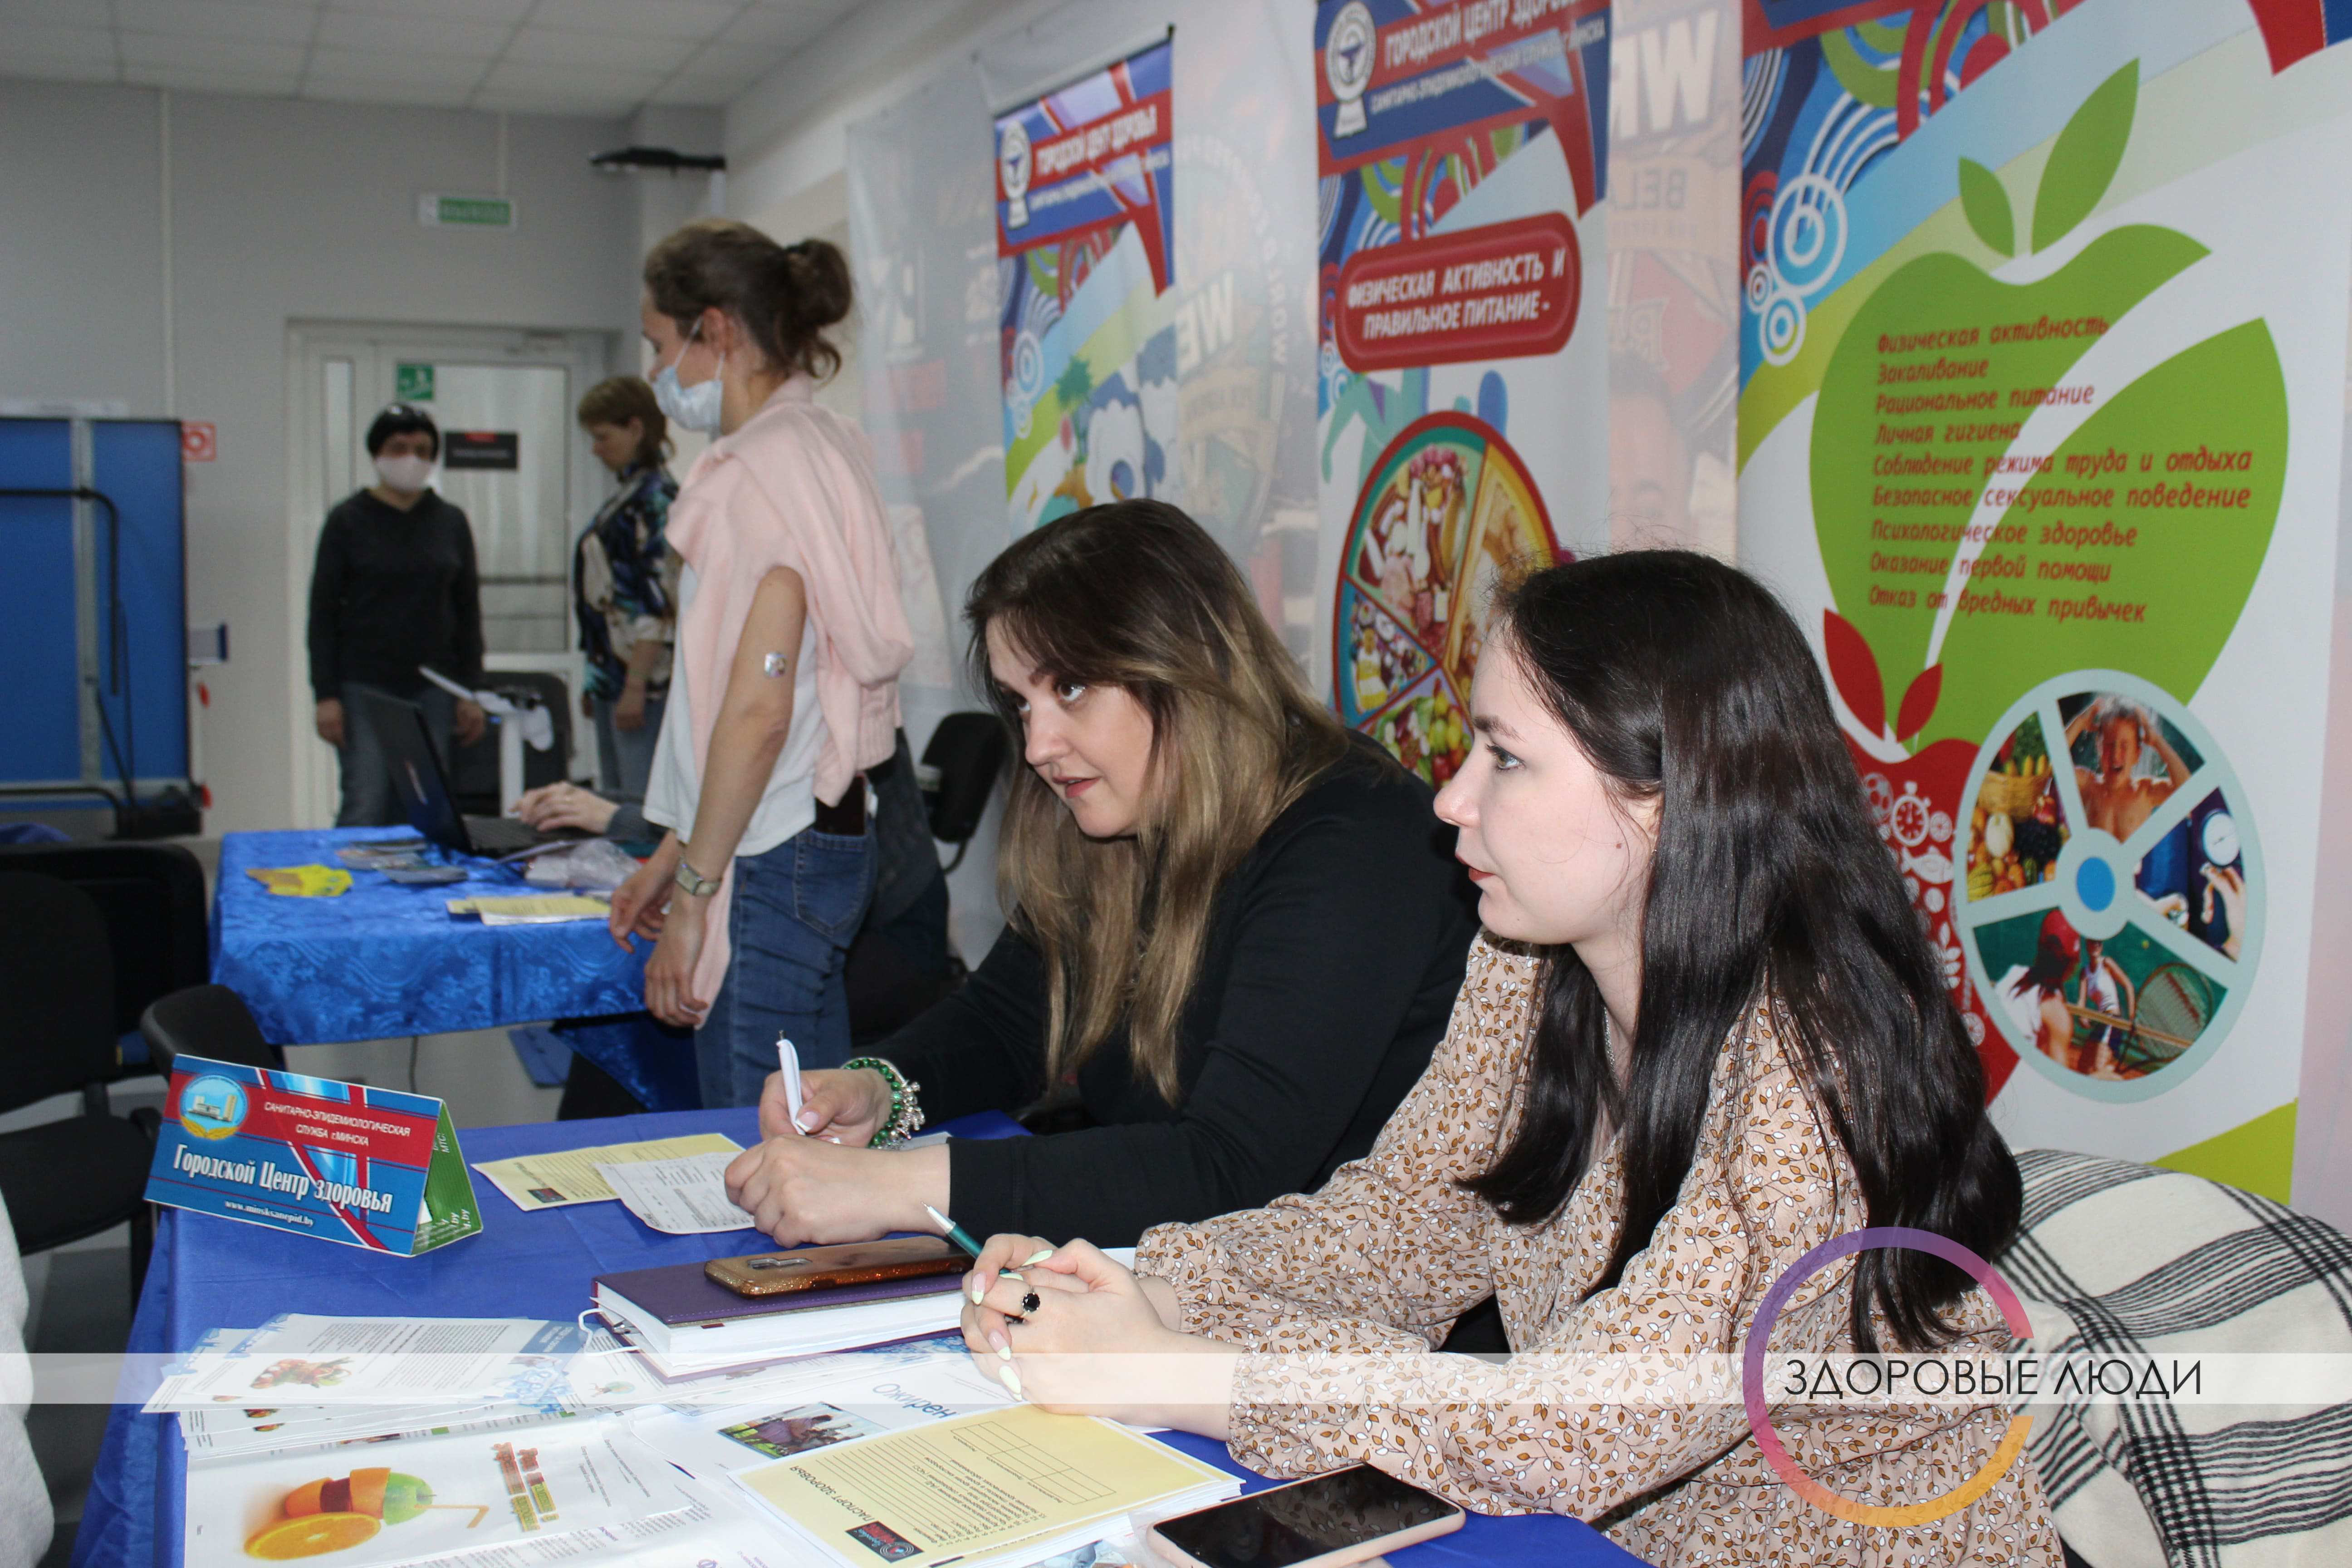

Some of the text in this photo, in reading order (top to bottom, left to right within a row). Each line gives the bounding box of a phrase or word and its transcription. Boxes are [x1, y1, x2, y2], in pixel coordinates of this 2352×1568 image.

[1385, 2, 1461, 69] ГОРОДСКОЙ
[1463, 0, 1510, 47] ЦЕНТР
[1348, 249, 1565, 309] ФИЗИЧЕСКАЯ АКТИВНОСТЬ И
[1363, 307, 1460, 340] ПРАВИЛЬНОЕ
[1463, 290, 1541, 328] ПИТАНИЕ
[1877, 315, 2110, 353] Физическая активность
[1877, 357, 1989, 385] Закаливание
[1875, 385, 2094, 416] Рациональное питание
[1875, 422, 2022, 444] Личная гигиена
[1874, 444, 2253, 479] Соблюдение режима труда и отдыха
[1873, 481, 2252, 513] Безопасное сексуальное поведение
[1872, 519, 2137, 551] Психологическое здоровье
[1871, 550, 2112, 585] Оказание первой помощи
[1869, 585, 2147, 624] Отказ от вредных привычек
[264, 1102, 411, 1137] САНИТАРНО-ЭПИДЕМИОЛОГИЧЕСКАЯ
[295, 1124, 328, 1138] СЛУЖБА
[173, 1143, 393, 1214] Городской Центр здоровья
[225, 1200, 314, 1228] www.minsksanepid.by
[872, 1383, 958, 1418] Ожирен
[789, 1465, 875, 1522] ПАСПОРТ ЗДОРОВЬЯ
